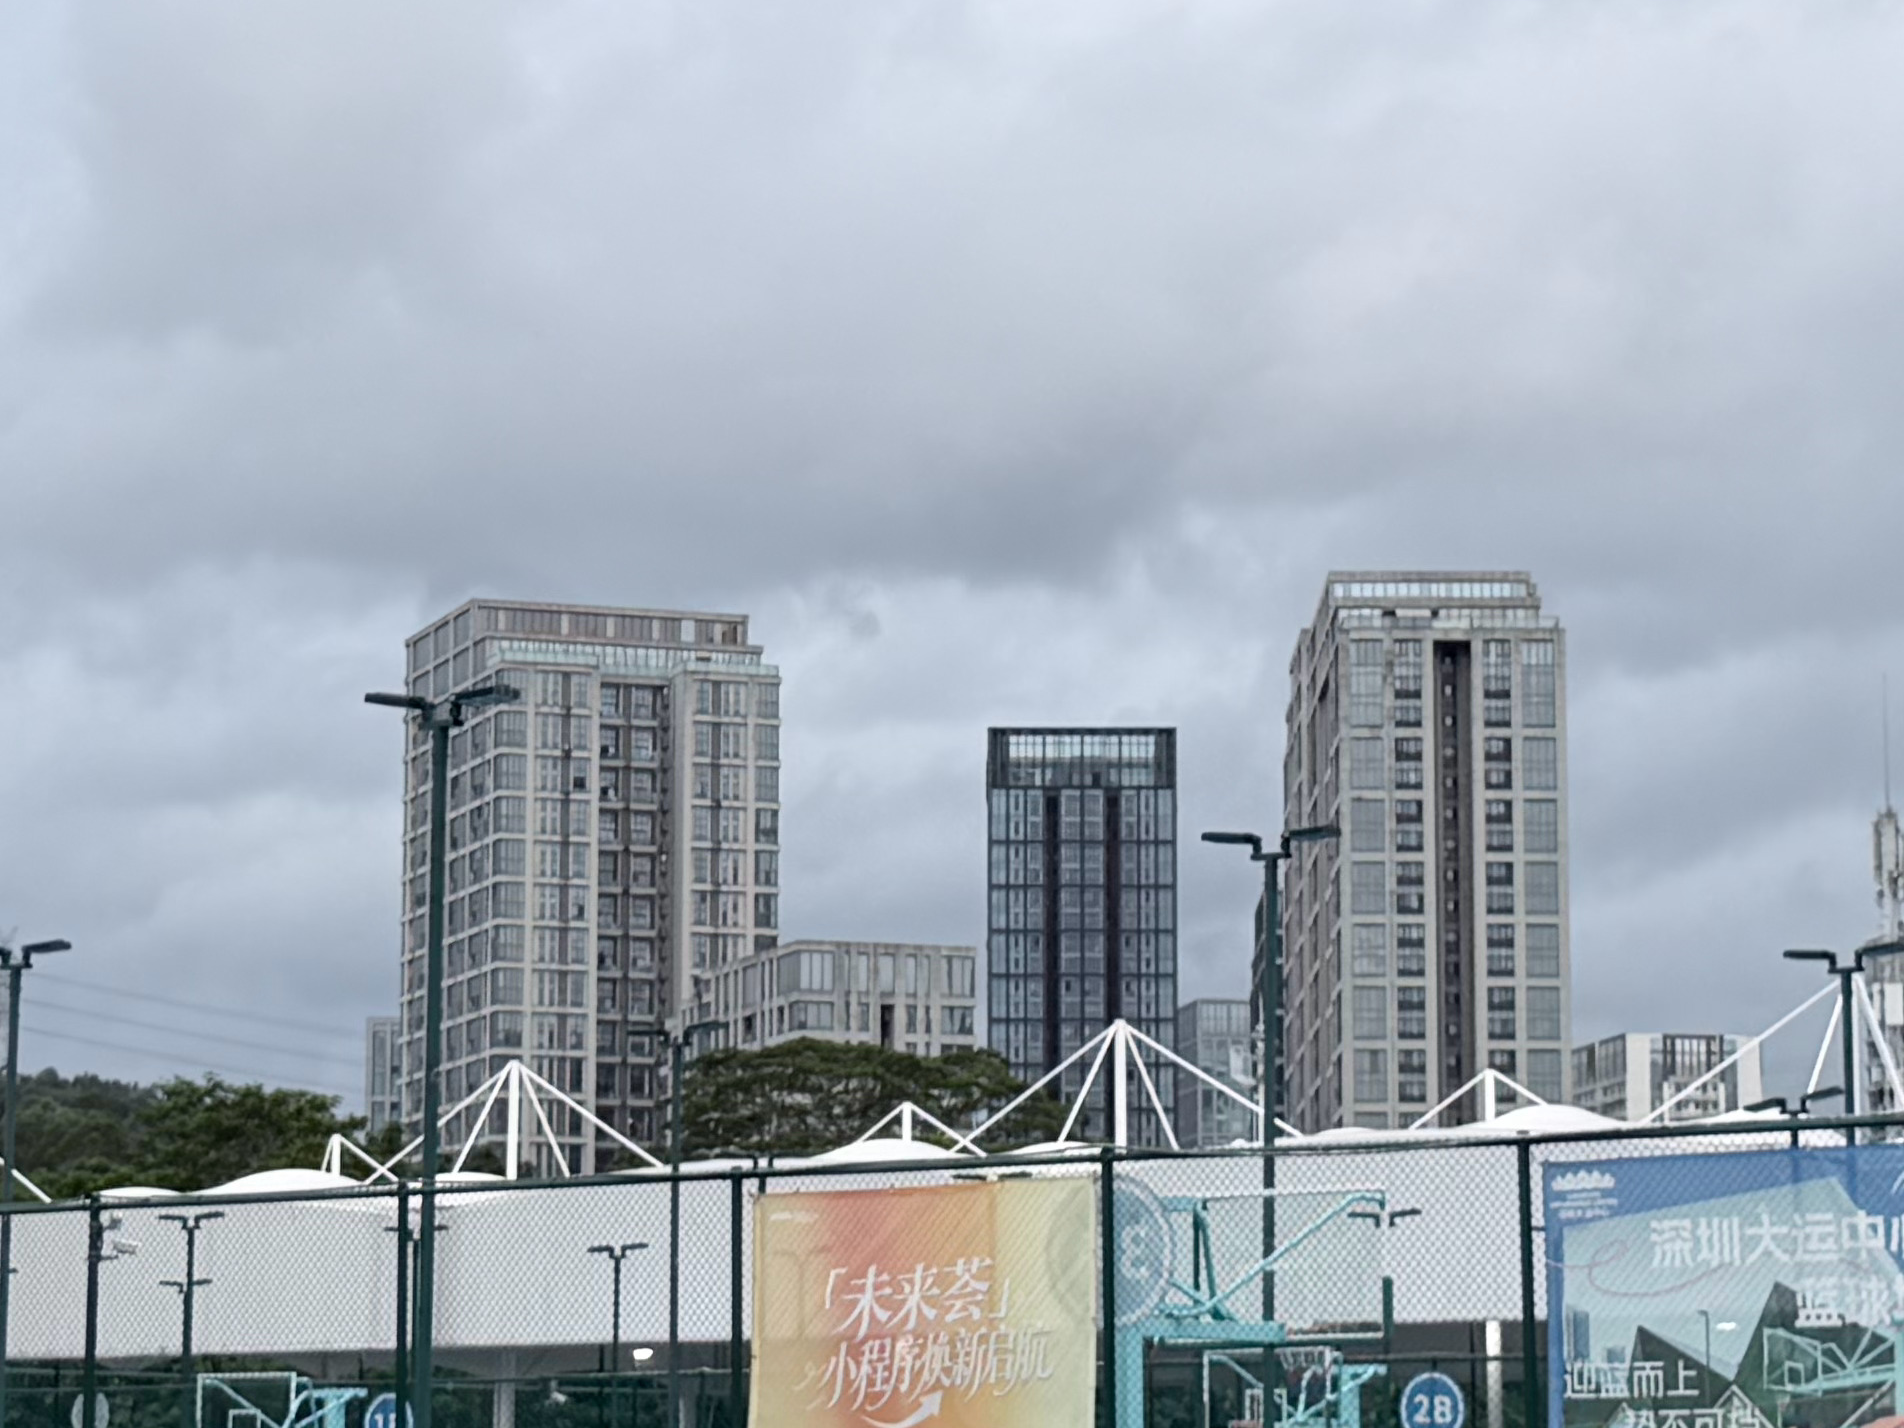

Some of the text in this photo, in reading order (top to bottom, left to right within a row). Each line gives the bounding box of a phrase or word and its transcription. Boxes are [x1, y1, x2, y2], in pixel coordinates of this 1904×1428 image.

[817, 1321, 1055, 1412] 小程序焕新启航
[1564, 1359, 1700, 1399] 迎篮而上
[1413, 1394, 1453, 1424] 2B
